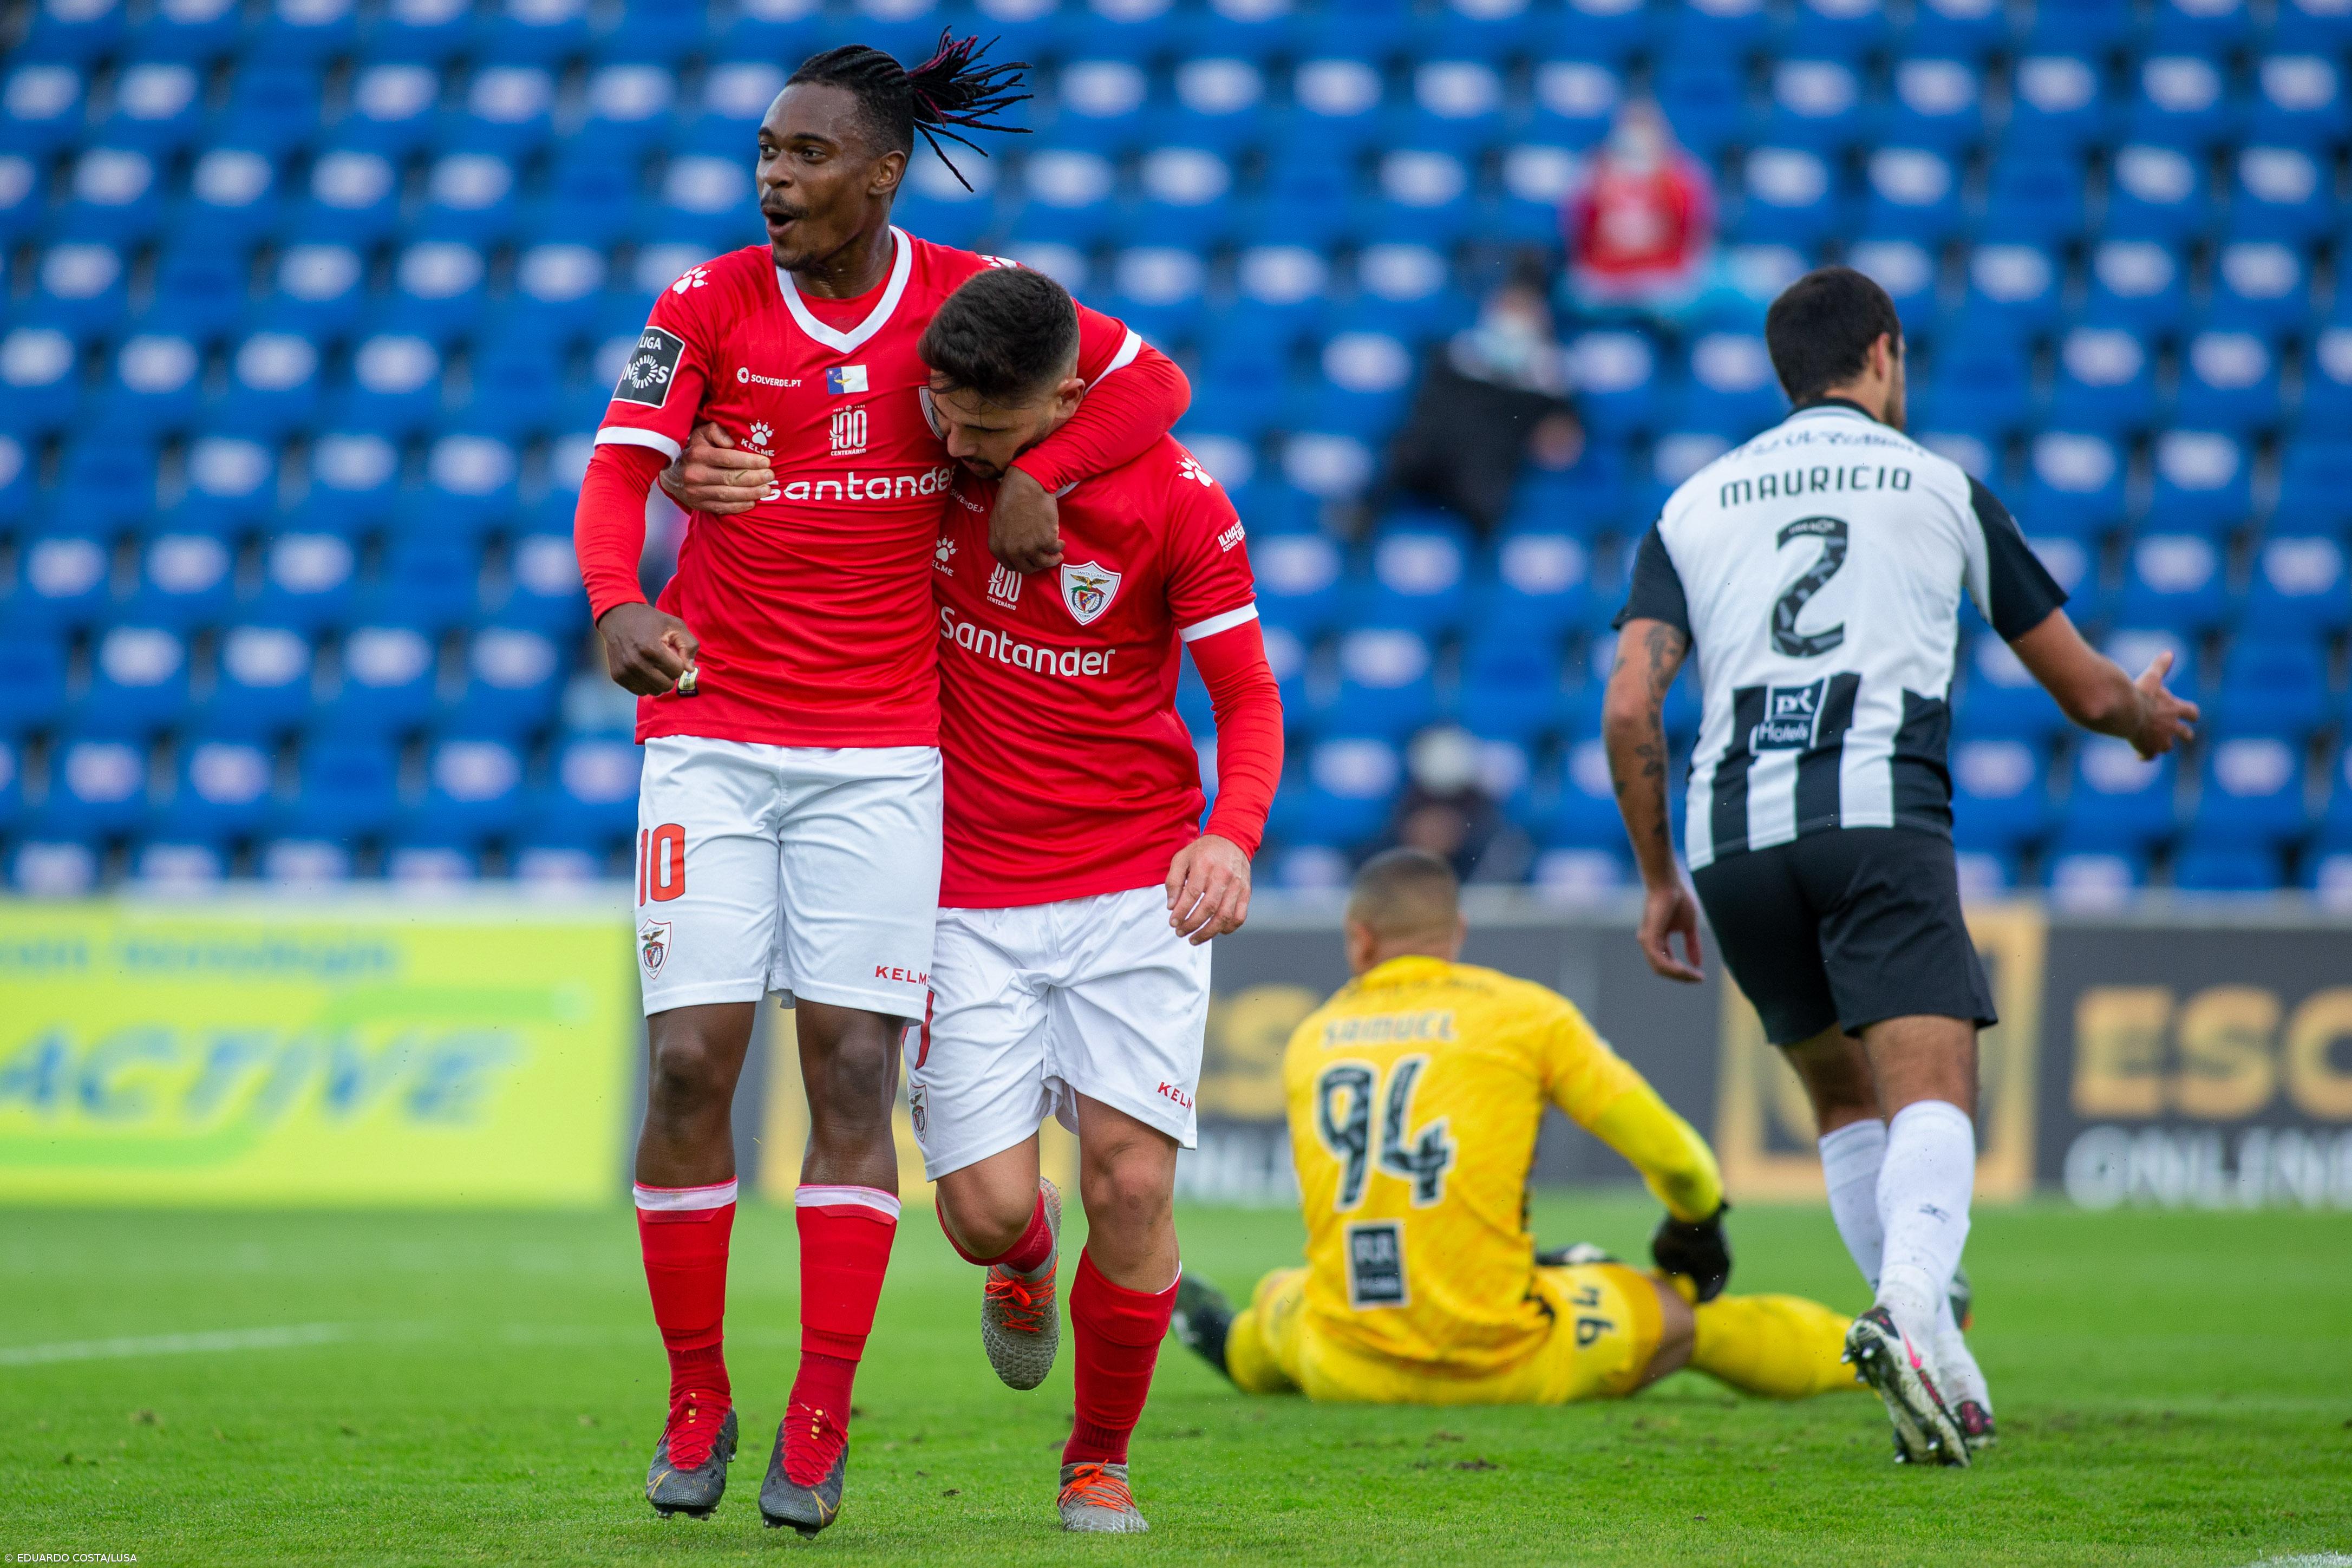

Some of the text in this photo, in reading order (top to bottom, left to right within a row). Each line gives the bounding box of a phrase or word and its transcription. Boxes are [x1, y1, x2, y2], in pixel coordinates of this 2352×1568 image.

[639, 336, 662, 350] LIGA
[624, 355, 670, 389] NOS
[750, 374, 801, 387] SOLVERDE.PT
[741, 439, 775, 456] KELME
[830, 410, 866, 449] 100
[1720, 465, 1912, 509] MAURICIO
[1218, 525, 1237, 547] ILHA
[1770, 515, 1848, 658] 2
[940, 606, 1116, 677] Santander
[639, 823, 685, 907] 10
[1322, 1009, 1456, 1050] SAMUEL
[1318, 1057, 1453, 1207] 94
[1571, 1284, 1615, 1347] 94
